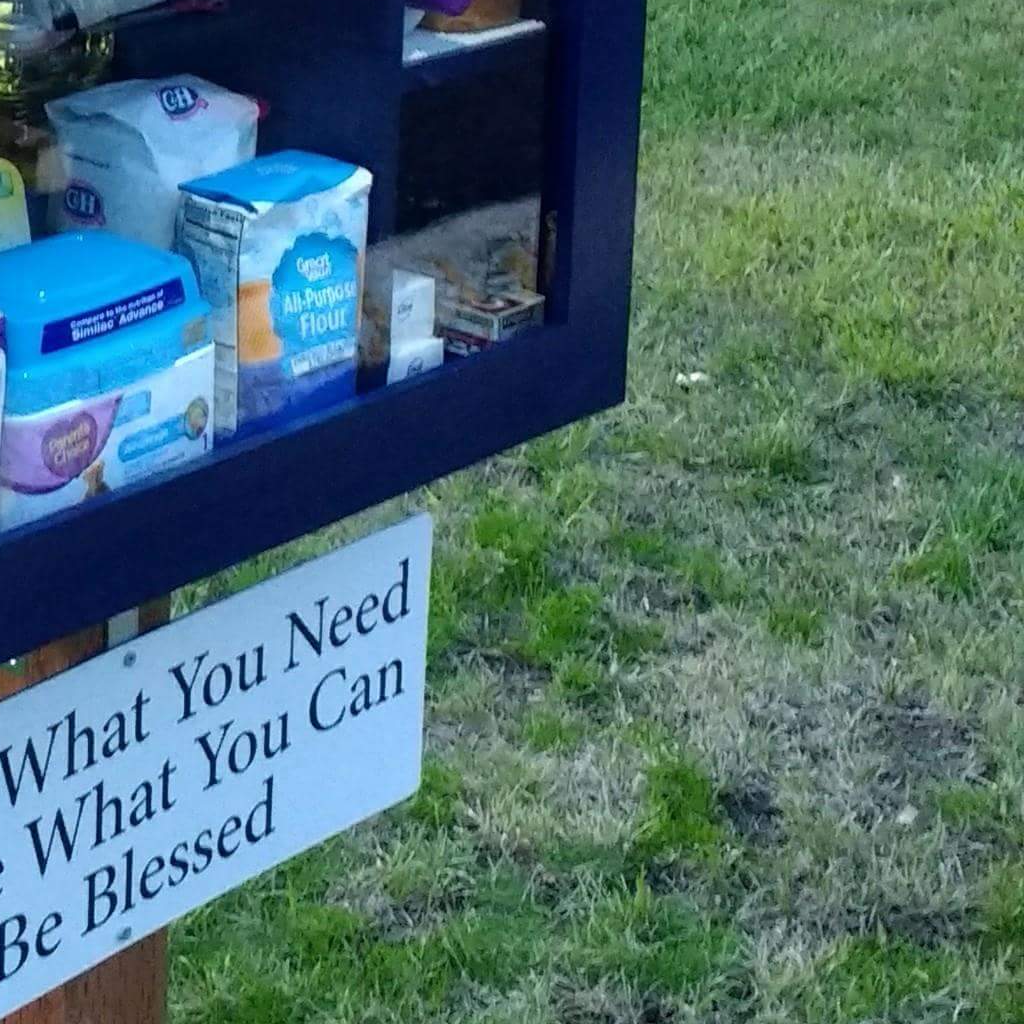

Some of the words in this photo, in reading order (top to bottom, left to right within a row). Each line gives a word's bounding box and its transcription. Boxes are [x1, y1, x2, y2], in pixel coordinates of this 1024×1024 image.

[119, 300, 164, 326] Advance
[299, 309, 346, 340] Flour
[169, 644, 267, 723] You
[284, 559, 411, 673] Need
[25, 767, 179, 880] What
[196, 710, 292, 793] You
[309, 659, 405, 733] Can
[80, 776, 276, 937] Blessed
